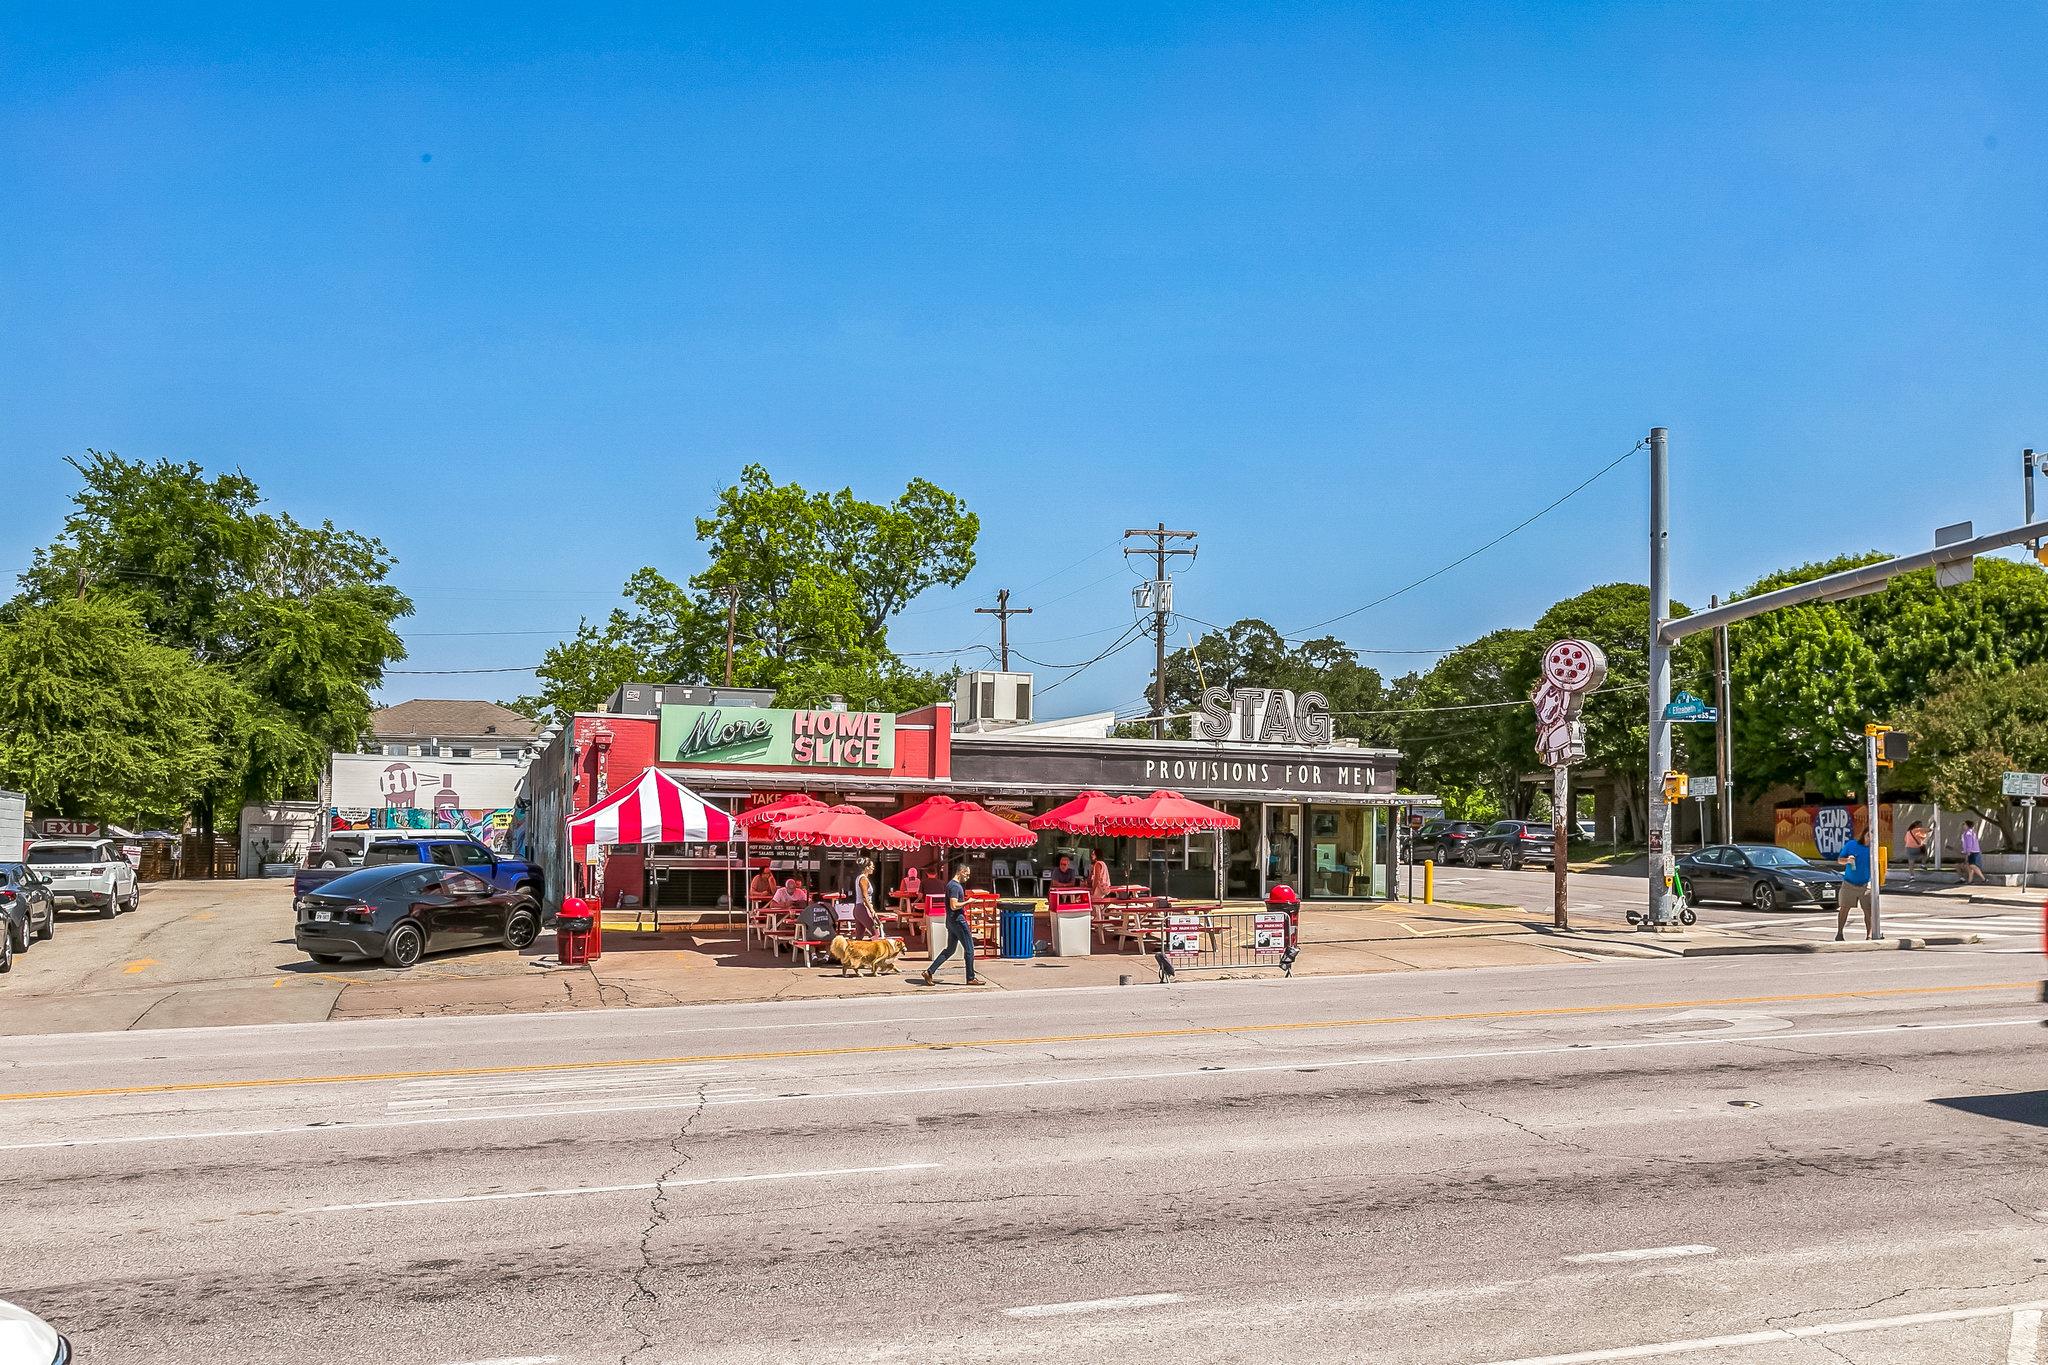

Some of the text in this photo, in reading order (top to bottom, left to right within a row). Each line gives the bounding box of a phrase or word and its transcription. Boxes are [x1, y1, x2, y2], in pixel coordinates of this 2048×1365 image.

[794, 711, 882, 738] HOME
[1200, 686, 1330, 743] STAG
[680, 709, 772, 755] More
[793, 735, 881, 764] SLICE
[381, 767, 417, 796] HI
[1146, 760, 1375, 786] PROVISIONS FOR MEN
[751, 793, 782, 805] TAKE
[46, 822, 89, 834] EXIT
[1819, 809, 1848, 828] FIND
[1815, 826, 1850, 853] PEACE
